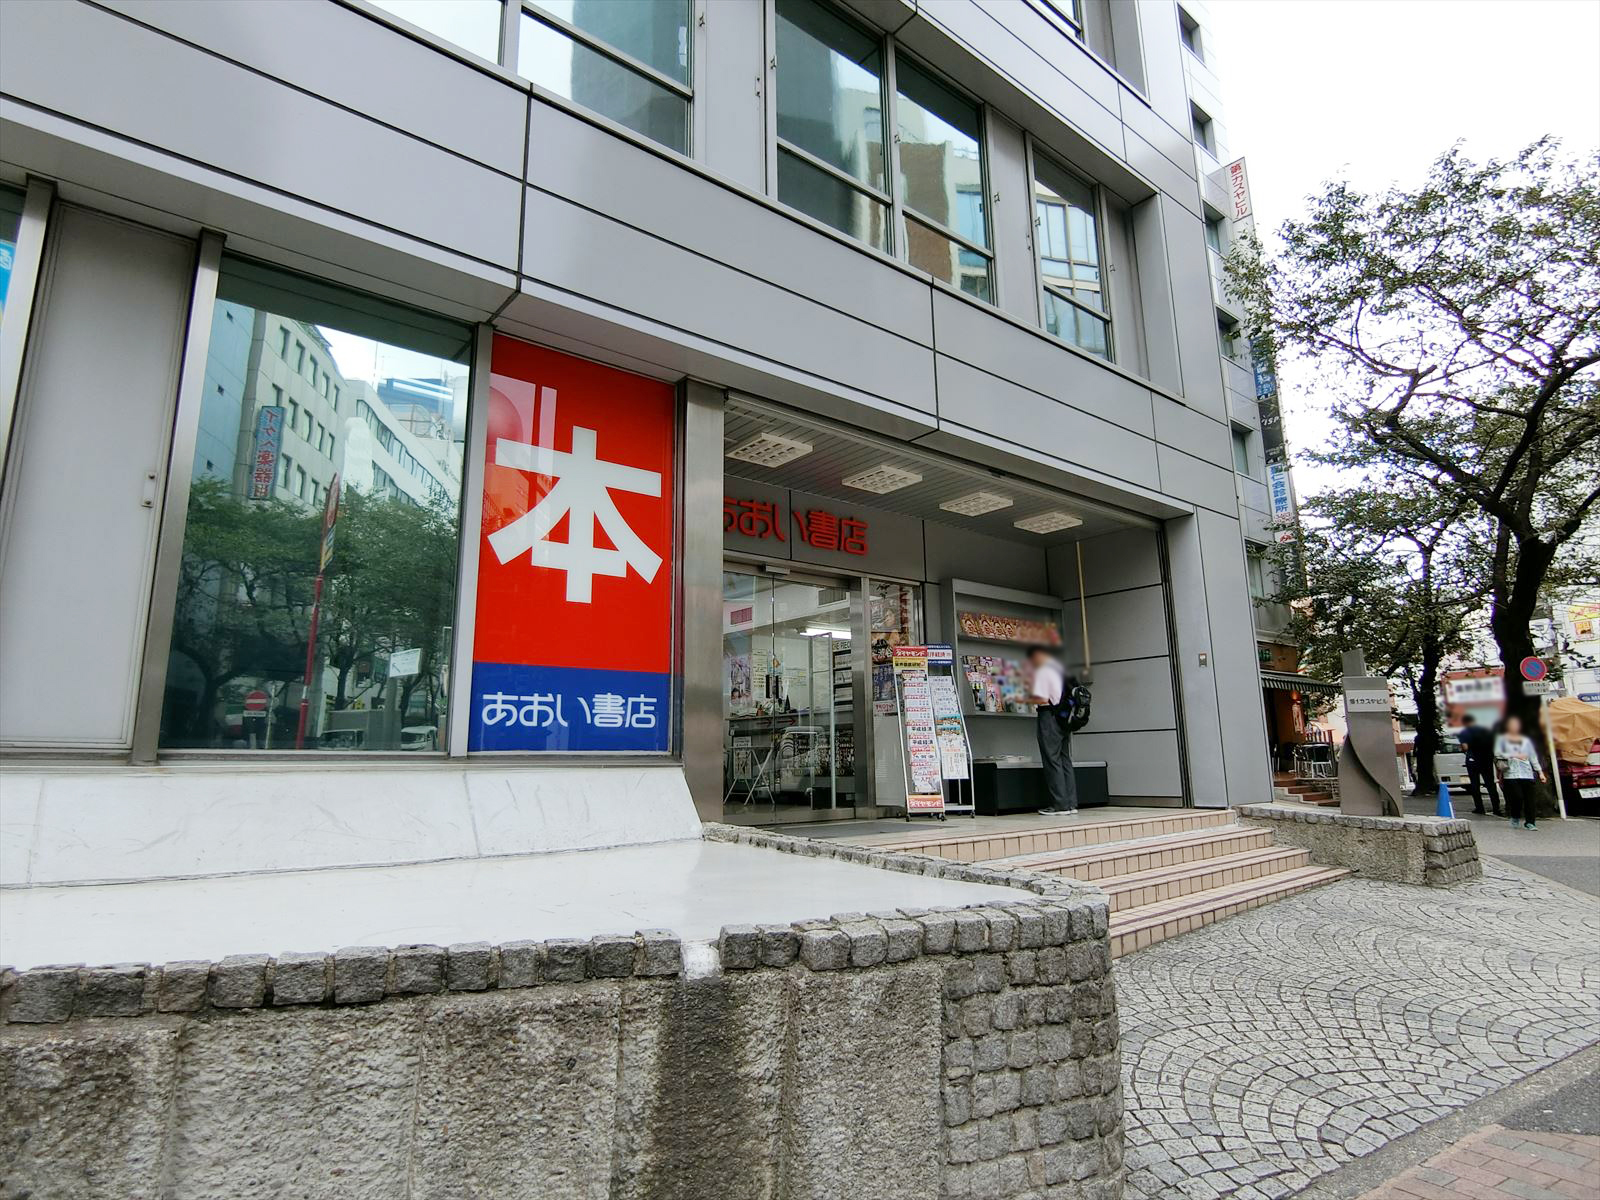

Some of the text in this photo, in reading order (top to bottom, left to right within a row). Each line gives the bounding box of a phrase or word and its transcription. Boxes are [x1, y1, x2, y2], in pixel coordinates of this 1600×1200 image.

[487, 425, 663, 604] 本
[481, 691, 657, 728] あおい書店
